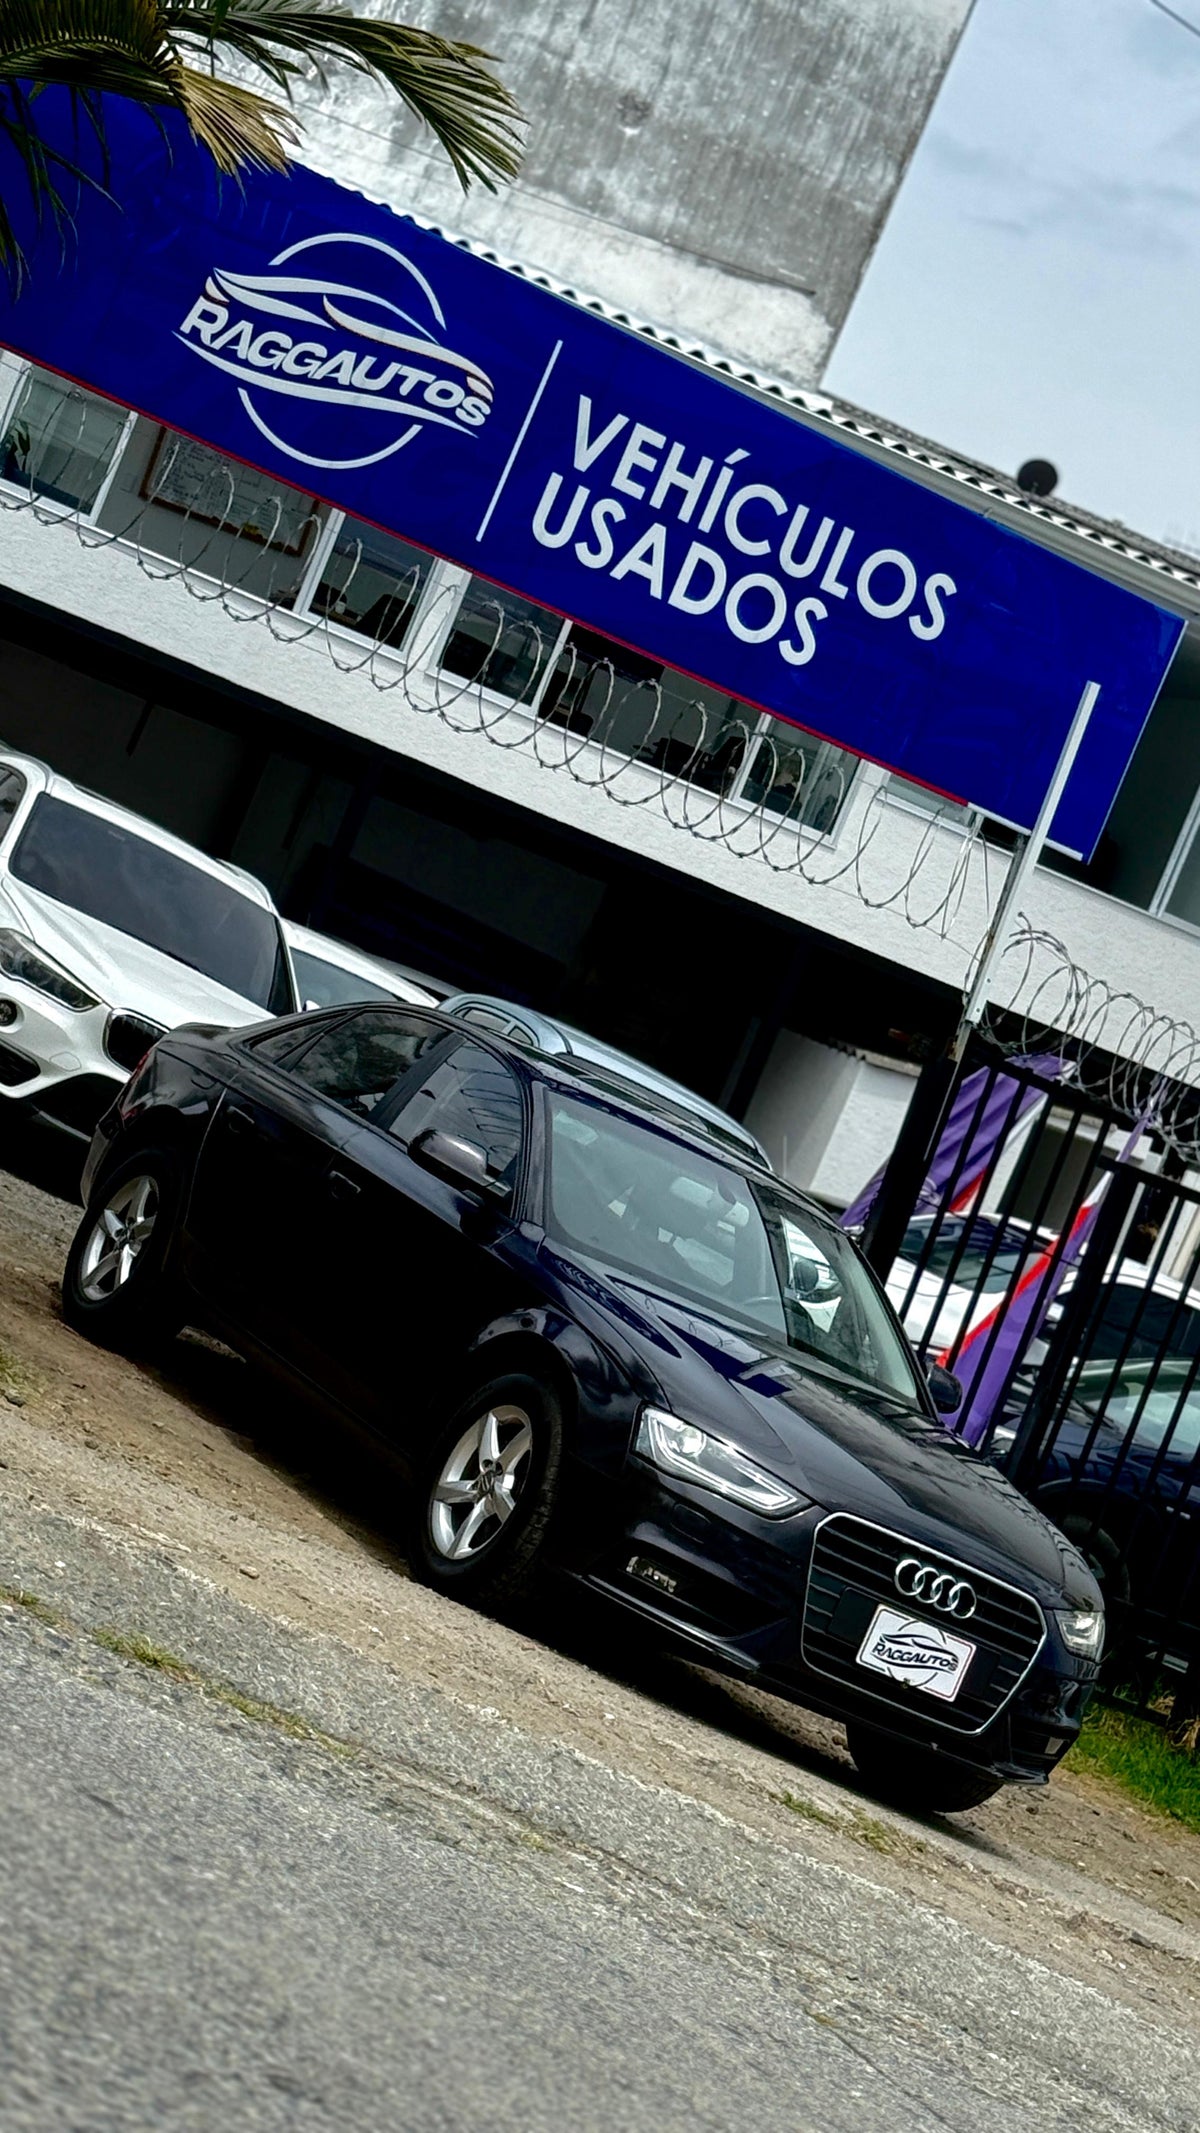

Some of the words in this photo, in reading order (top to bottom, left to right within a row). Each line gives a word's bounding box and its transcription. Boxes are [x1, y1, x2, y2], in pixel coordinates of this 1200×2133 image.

[179, 296, 492, 427] RAGGAUTOS
[531, 472, 828, 666] USADOS
[573, 395, 957, 641] VEHÍCULOS
[872, 1643, 958, 1672] RAGGAUTOS
